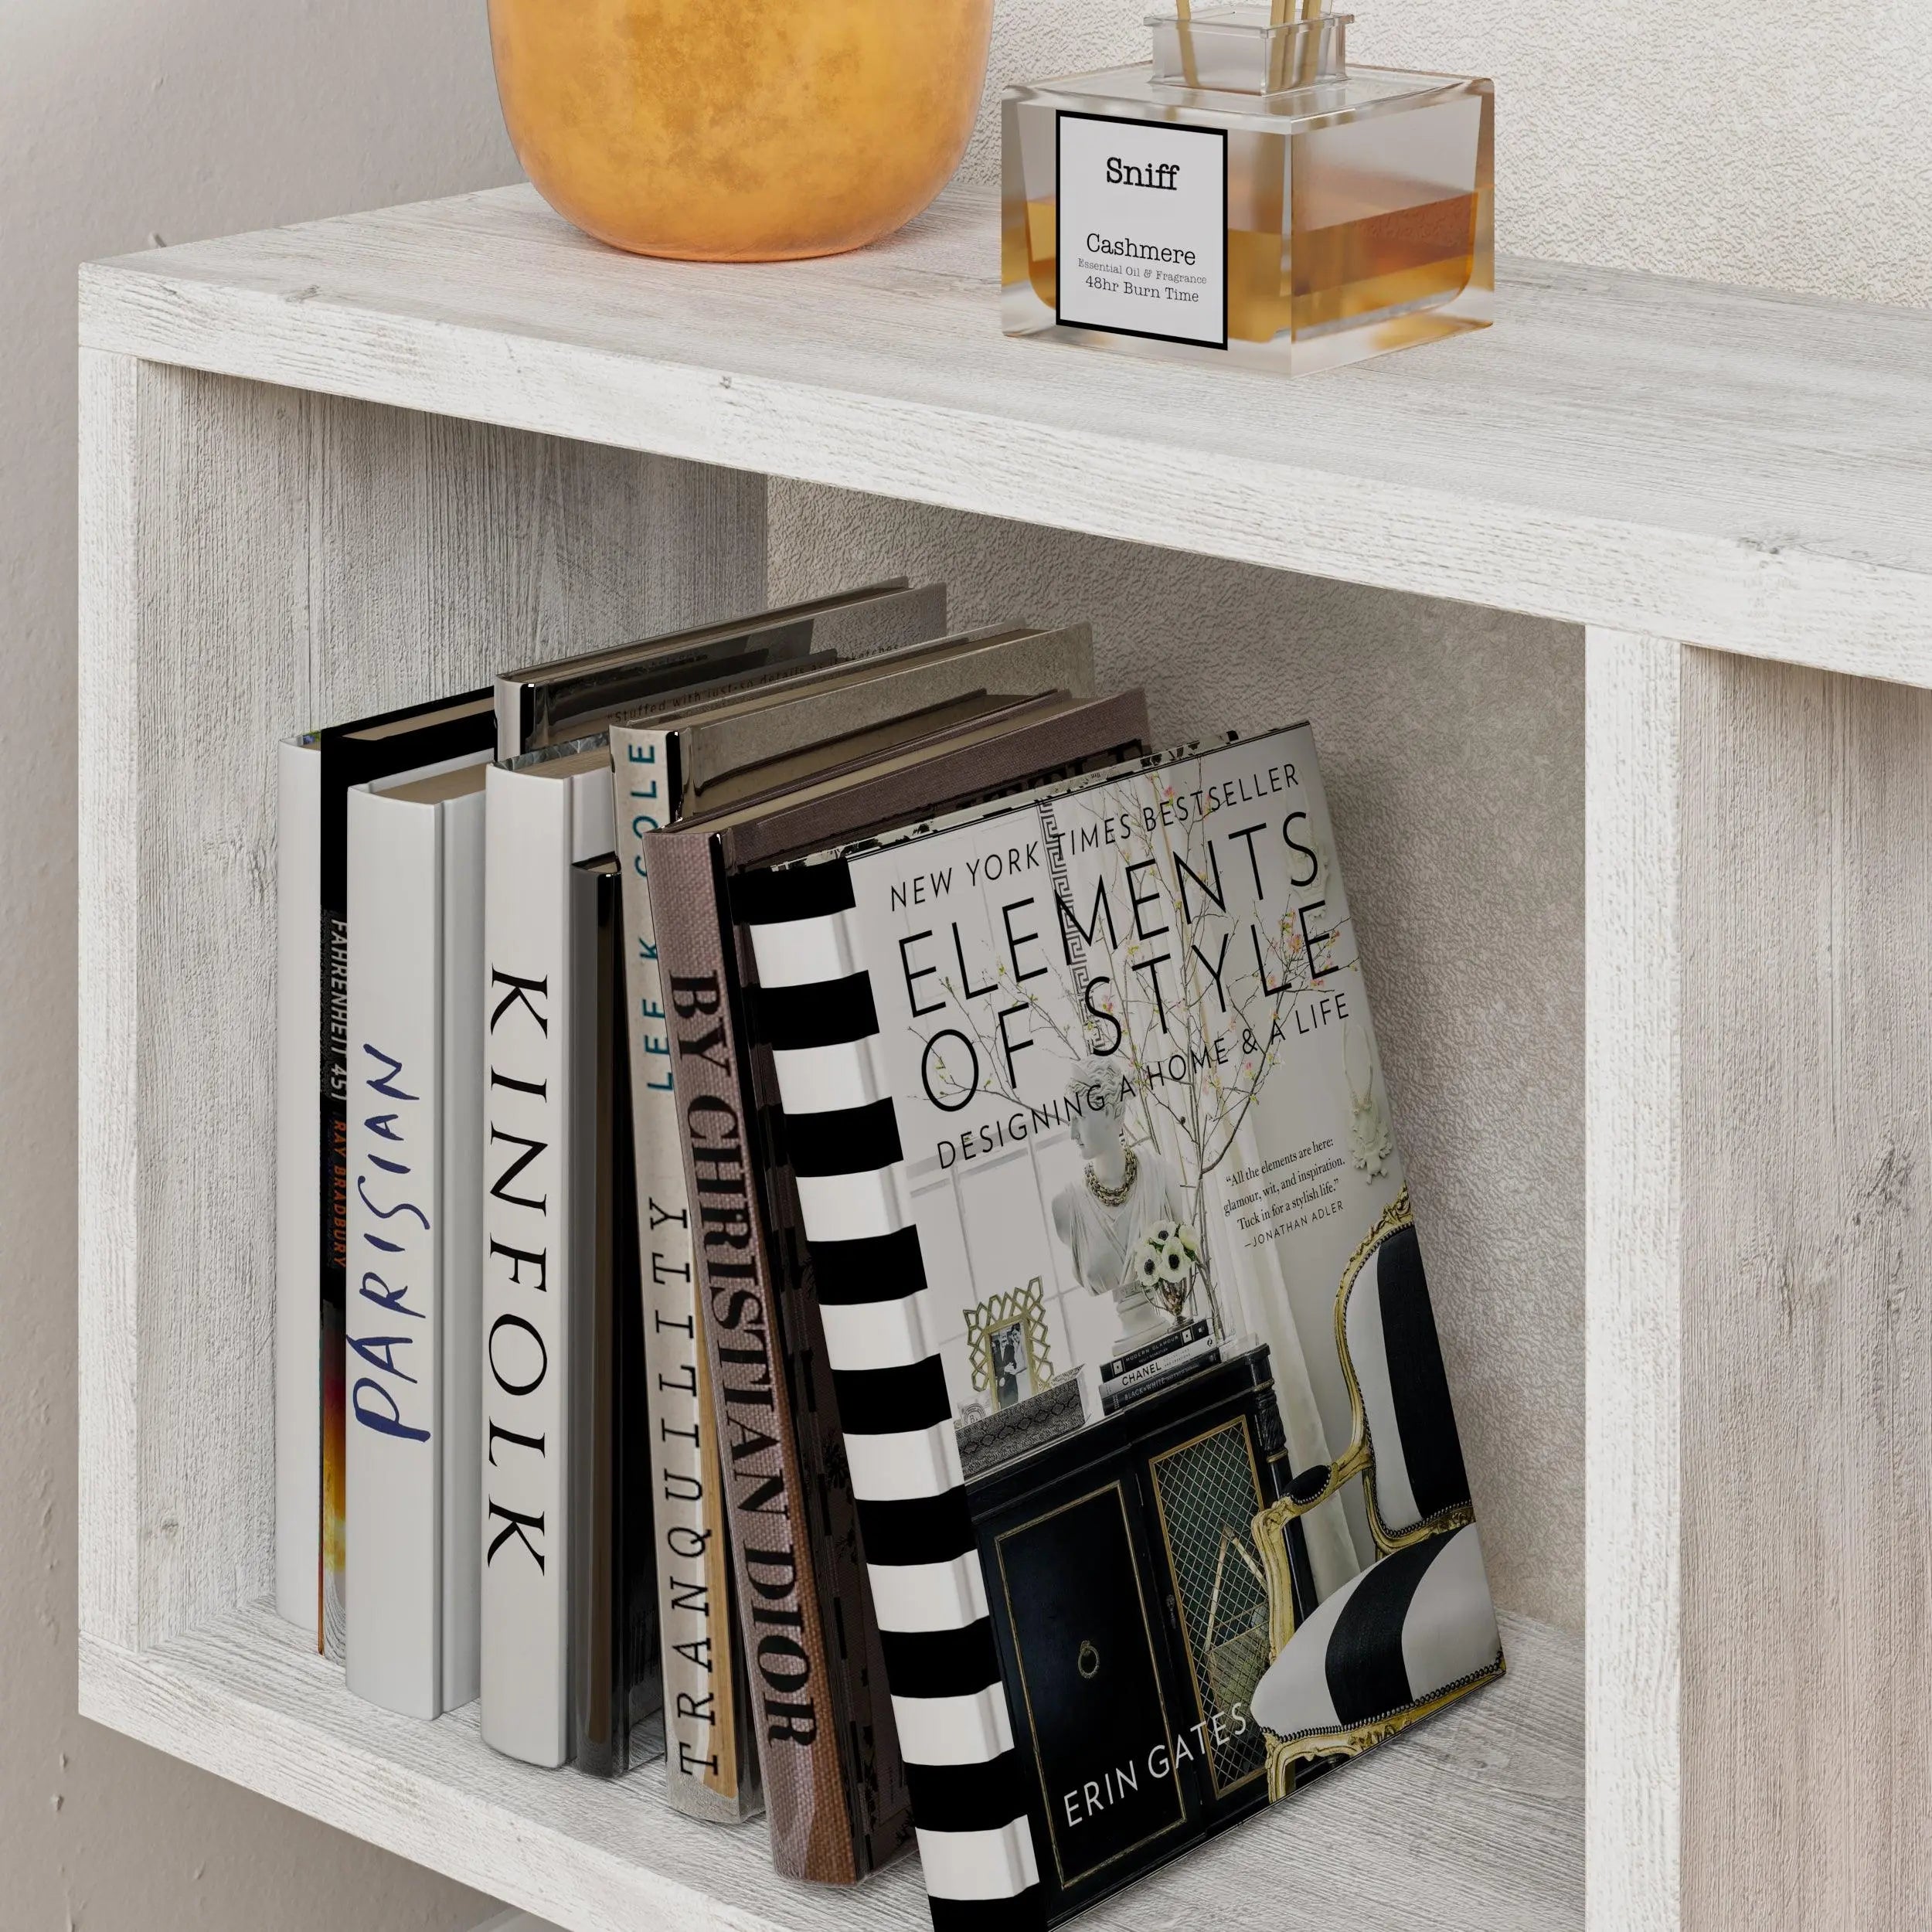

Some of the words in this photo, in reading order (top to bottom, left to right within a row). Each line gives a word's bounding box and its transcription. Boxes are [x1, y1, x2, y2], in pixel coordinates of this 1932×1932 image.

[1106, 157, 1180, 190] Sniff
[1077, 257, 1122, 275] Essential
[1125, 266, 1140, 277] Oil
[1143, 269, 1153, 278] &
[1156, 270, 1207, 287] Fragrance
[1085, 275, 1119, 293] 48hr
[1123, 281, 1160, 298] Burn
[1165, 287, 1199, 302] Time
[1086, 233, 1196, 265] Cashmere
[889, 866, 953, 912] NEW
[965, 841, 1041, 886] YORK
[1052, 812, 1132, 859] TIMES
[1143, 763, 1299, 832] BESTSELLER
[898, 811, 1318, 1018] ELEMENTS
[331, 917, 348, 1059] FAHRENHEIT
[668, 969, 732, 1077] BY
[921, 1002, 1035, 1113] OF
[1083, 900, 1340, 1056] STYLE
[330, 1063, 347, 1100] 451
[936, 1084, 1106, 1169] DESIGNING
[1120, 1075, 1138, 1098] A
[1146, 1036, 1229, 1087] HOME
[1241, 1027, 1259, 1055] &
[1269, 1016, 1286, 1046] A
[1295, 992, 1350, 1036] LIFE
[333, 1119, 347, 1158] RAY
[1223, 1192, 1262, 1217] glamour,
[1263, 1182, 1280, 1196] wit,
[1281, 1172, 1298, 1189] and
[1298, 1157, 1345, 1182] inspiration.
[1226, 1172, 1244, 1187] “All
[1246, 1167, 1260, 1181] the
[1261, 1152, 1298, 1174] elements
[1298, 1147, 1312, 1159] are
[1313, 1137, 1334, 1153] here:
[333, 1165, 347, 1268] BRADBURY
[345, 1043, 431, 1443] PARISIAN
[1237, 1211, 1260, 1230] Tuck
[1261, 1209, 1271, 1221] in
[1271, 1202, 1284, 1217] for
[1285, 1202, 1291, 1211] a
[1291, 1187, 1320, 1211] stylish
[1320, 1178, 1339, 1197] life.”
[1311, 1199, 1344, 1223] ADLER
[486, 961, 549, 1577] KINFOLK
[687, 1094, 790, 1521] CHRISTIAN
[1121, 1362, 1162, 1386] CHANEL
[1125, 1348, 1151, 1362] MODERN
[1151, 1335, 1179, 1351] GLAMOUR
[648, 1196, 719, 1777] TRANQUILITY
[743, 1540, 817, 1749] DIOR
[1063, 1760, 1138, 1828] ERIN
[1148, 1702, 1247, 1778] GATES
